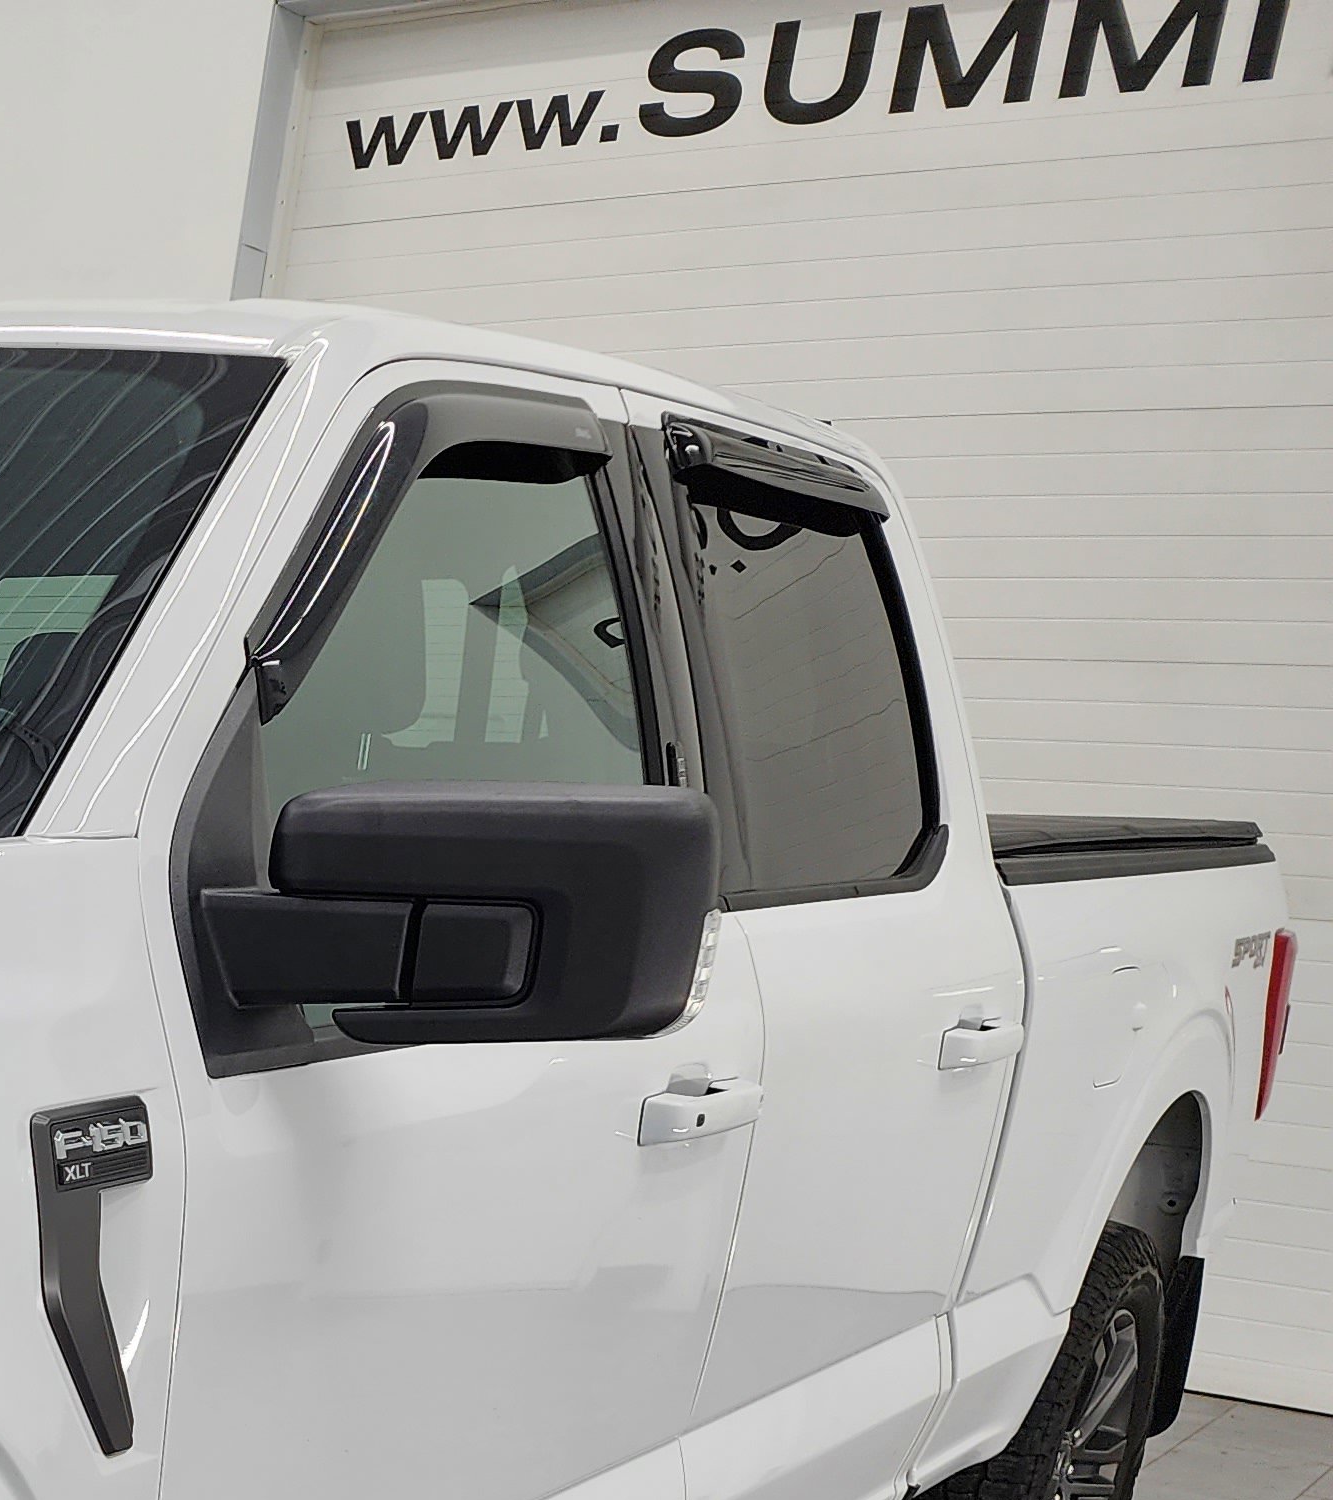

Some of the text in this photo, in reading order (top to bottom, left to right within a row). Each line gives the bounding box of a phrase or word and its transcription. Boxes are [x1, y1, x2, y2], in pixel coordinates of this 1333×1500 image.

[1231, 931, 1271, 968] SPORT
[53, 1118, 148, 1160] F-150
[64, 1162, 92, 1182] XLT
